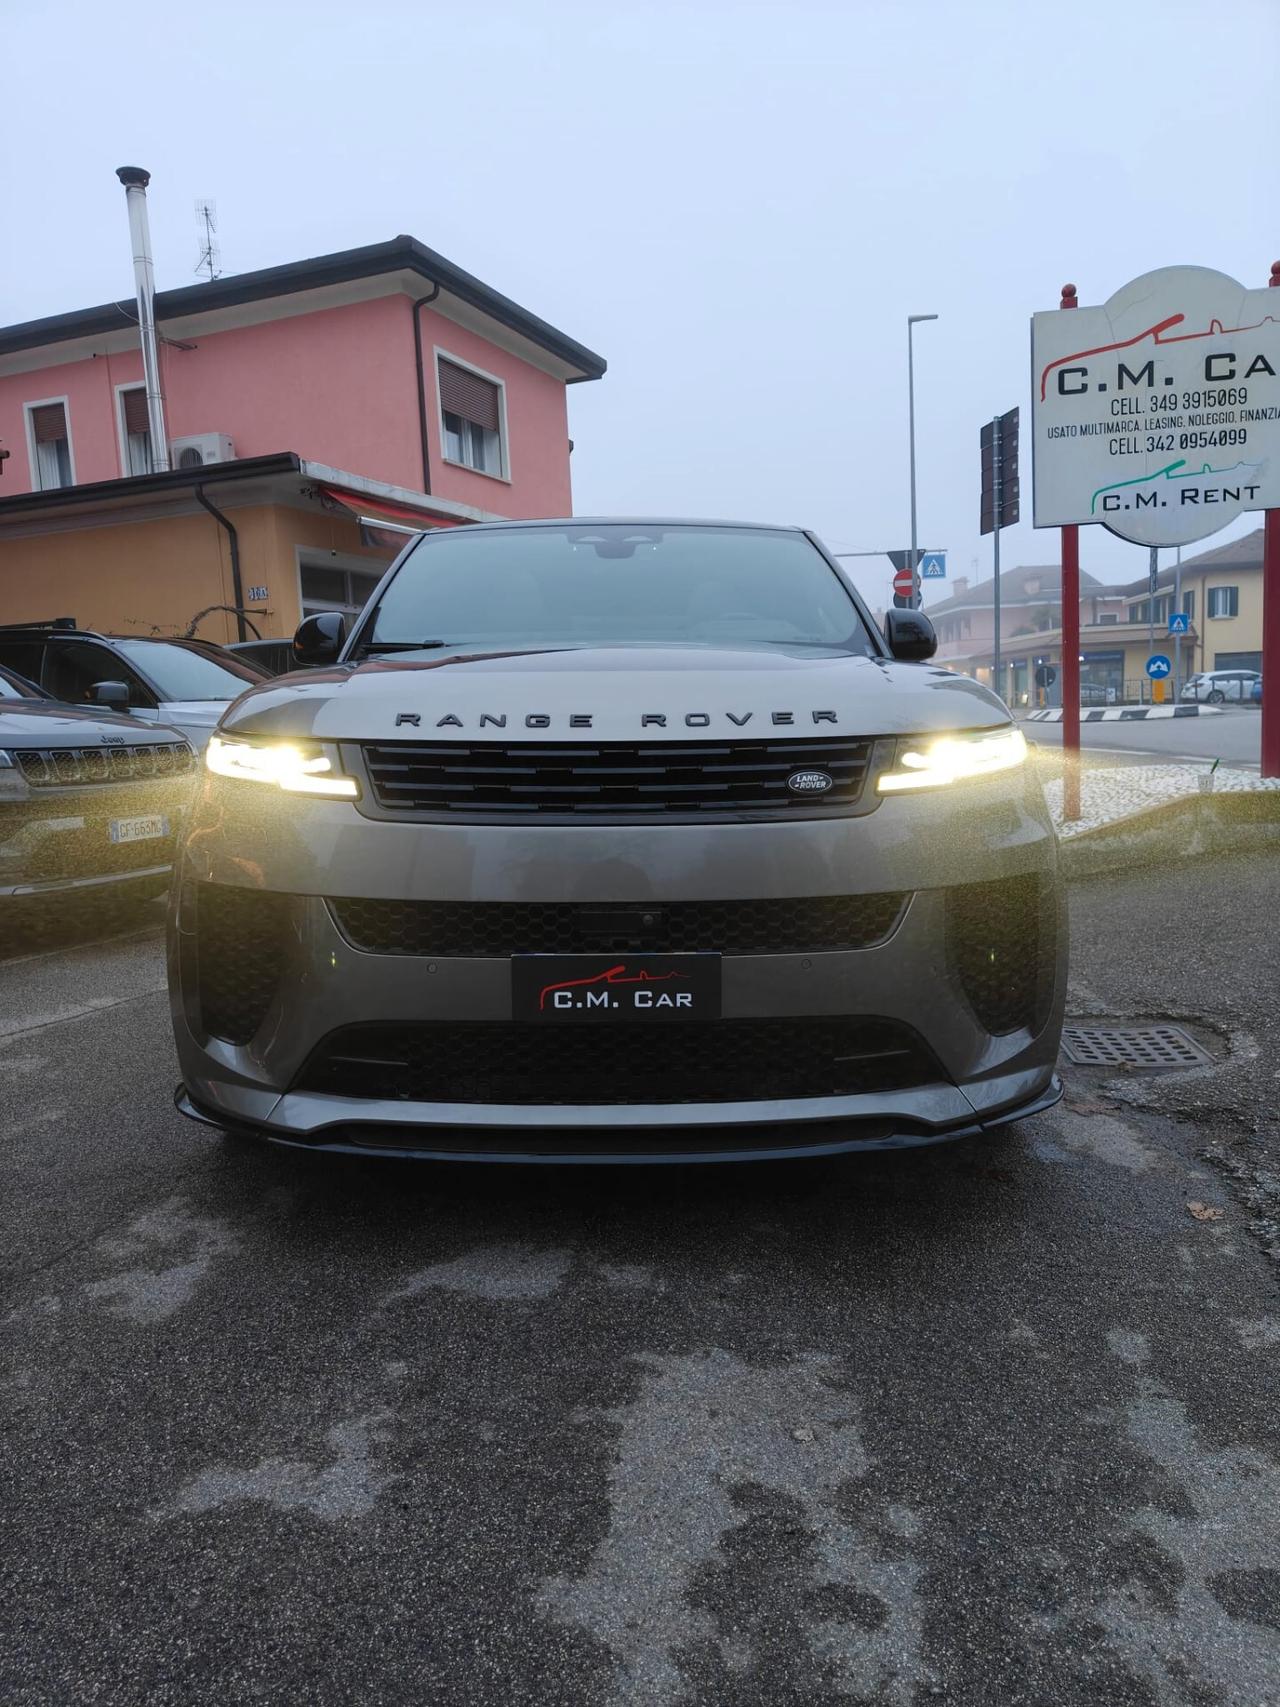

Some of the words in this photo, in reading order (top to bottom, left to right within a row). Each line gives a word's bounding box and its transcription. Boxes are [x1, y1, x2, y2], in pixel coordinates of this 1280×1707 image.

[1058, 361, 1174, 395] C.M.
[1111, 397, 1145, 416] CELL.
[1150, 394, 1178, 412] 349
[1182, 387, 1248, 410] 3915069
[1047, 425, 1077, 439] USATO
[1144, 415, 1186, 431] LEASING,
[1188, 410, 1237, 427] NOLEGGIO,
[1109, 438, 1143, 455] CELL.
[1146, 435, 1175, 453] 342
[1180, 428, 1247, 450] 0954099
[1103, 492, 1167, 511] C.M.
[1181, 486, 1260, 506] RENT
[395, 712, 593, 729] RANGE
[641, 709, 838, 728] ROVER
[796, 774, 819, 783] LAND
[799, 780, 827, 789] ROVER
[553, 991, 619, 1008] C.M.
